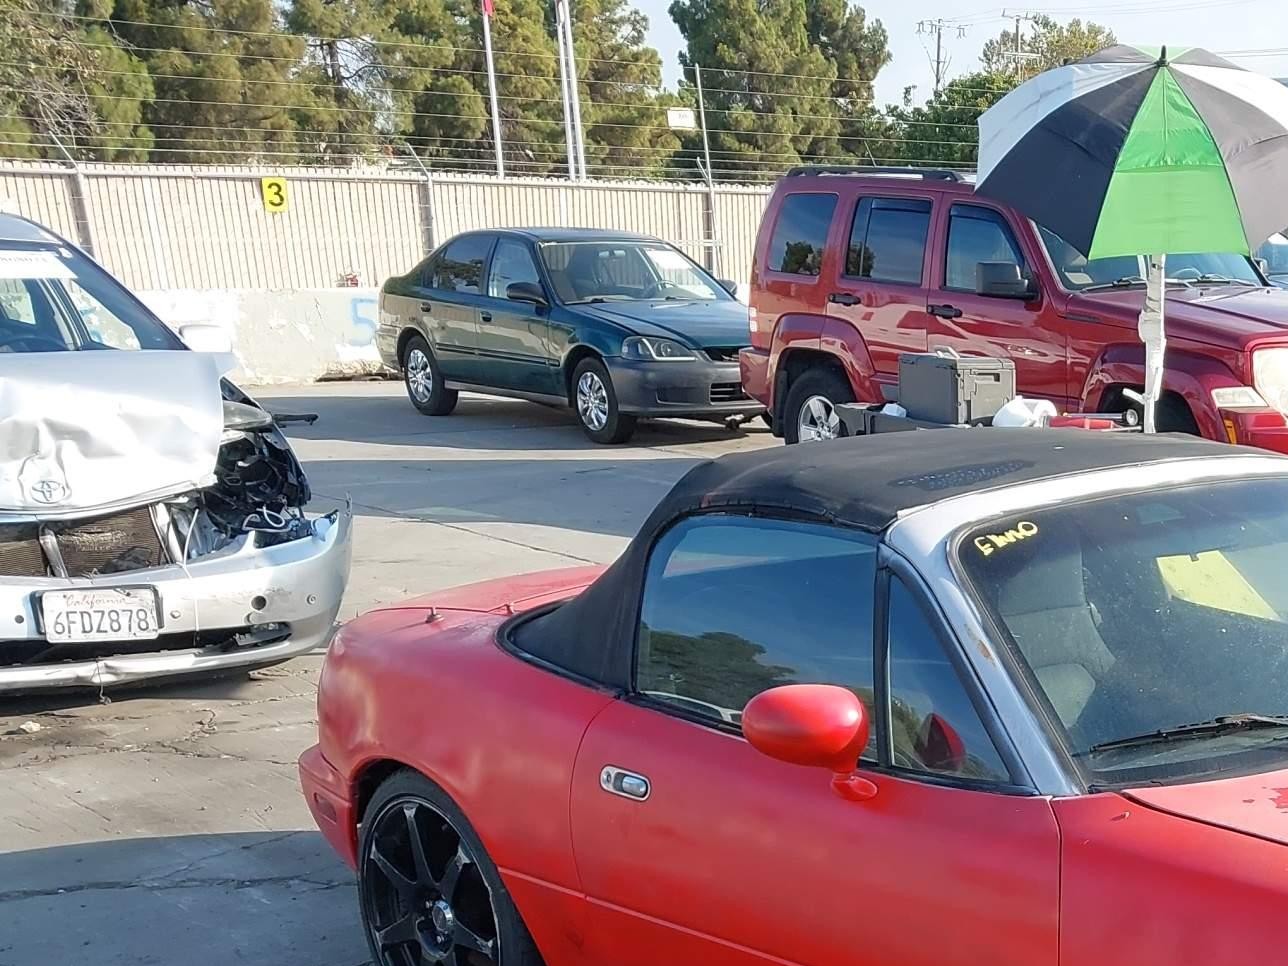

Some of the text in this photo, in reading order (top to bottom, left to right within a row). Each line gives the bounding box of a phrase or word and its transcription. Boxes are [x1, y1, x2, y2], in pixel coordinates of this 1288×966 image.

[267, 182, 285, 207] 3
[351, 298, 377, 346] 5
[53, 609, 150, 635] 6FDZ878
